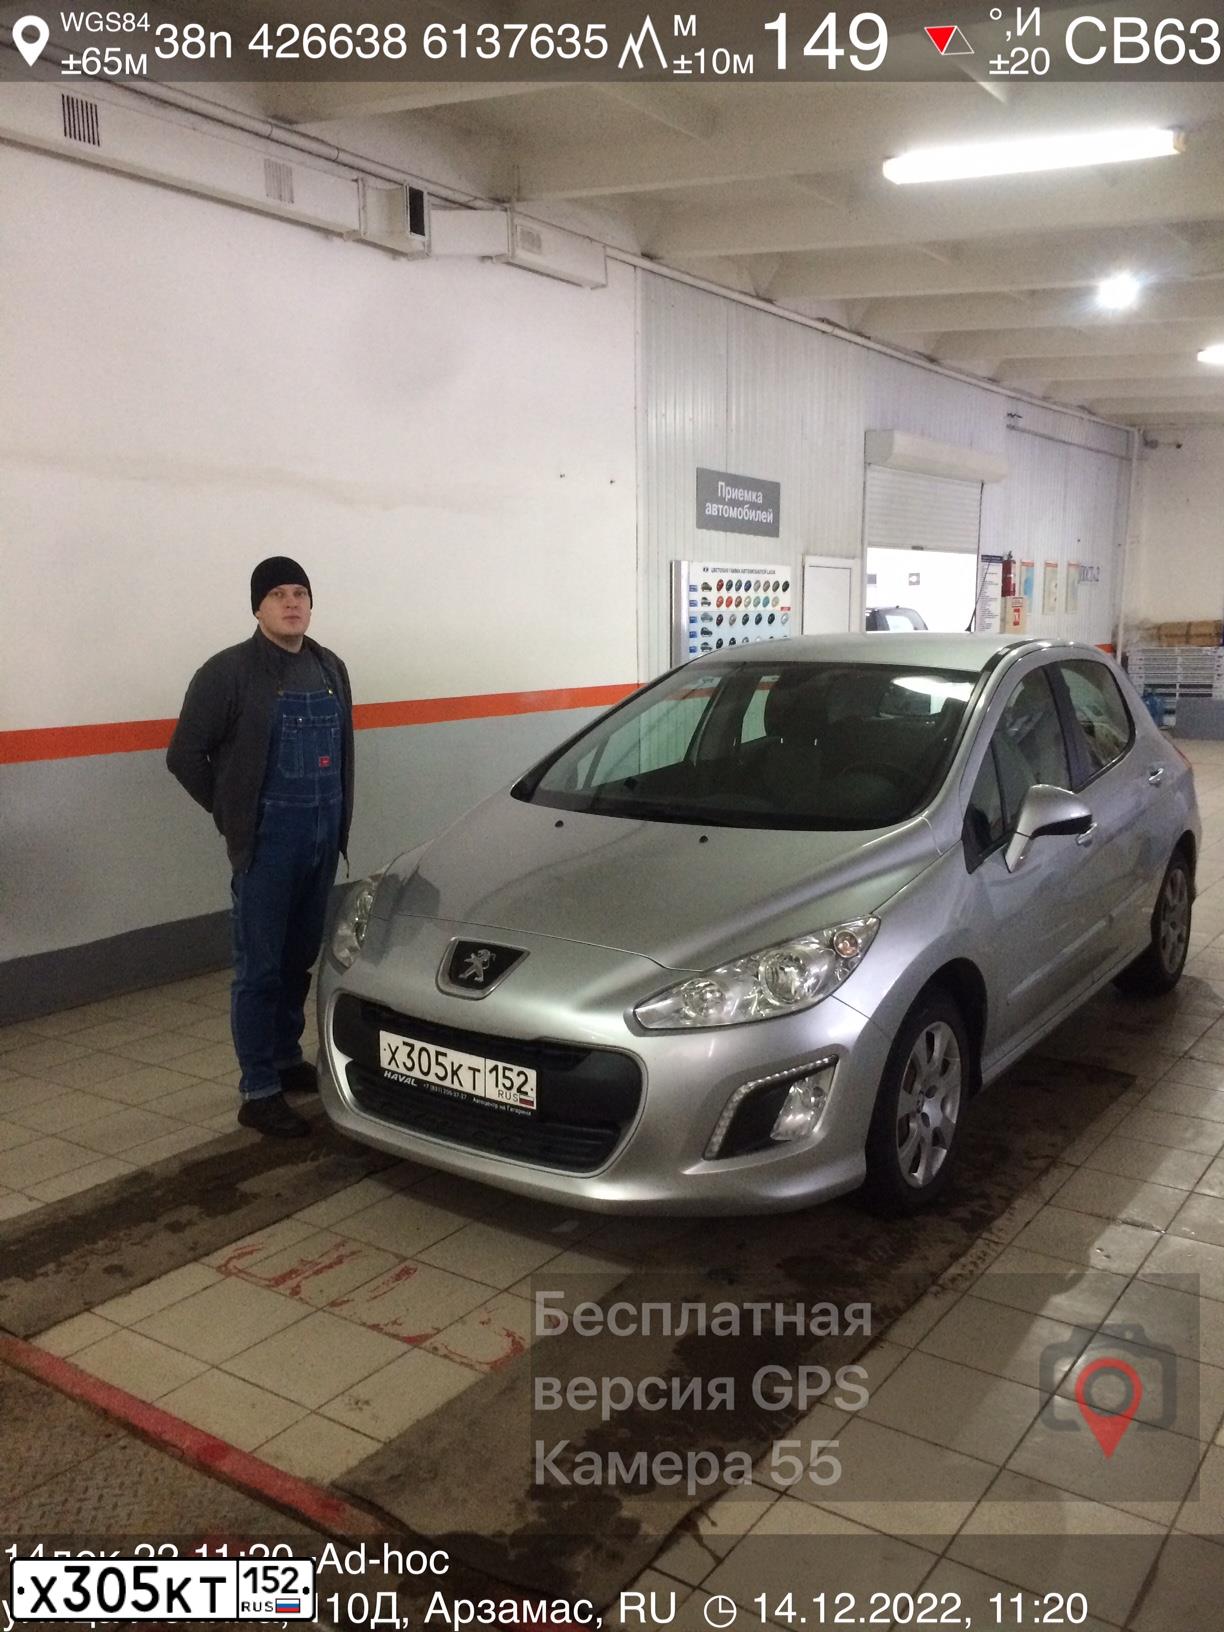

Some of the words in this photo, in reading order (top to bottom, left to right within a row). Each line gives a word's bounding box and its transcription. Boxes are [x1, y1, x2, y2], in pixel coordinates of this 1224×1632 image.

[718, 481, 763, 503] Приемка
[705, 502, 773, 523] автомобилей
[384, 1070, 417, 1087] HAVAL
[388, 1041, 480, 1091] Х305КТ
[489, 1064, 529, 1096] 152
[498, 1089, 519, 1103] RUS
